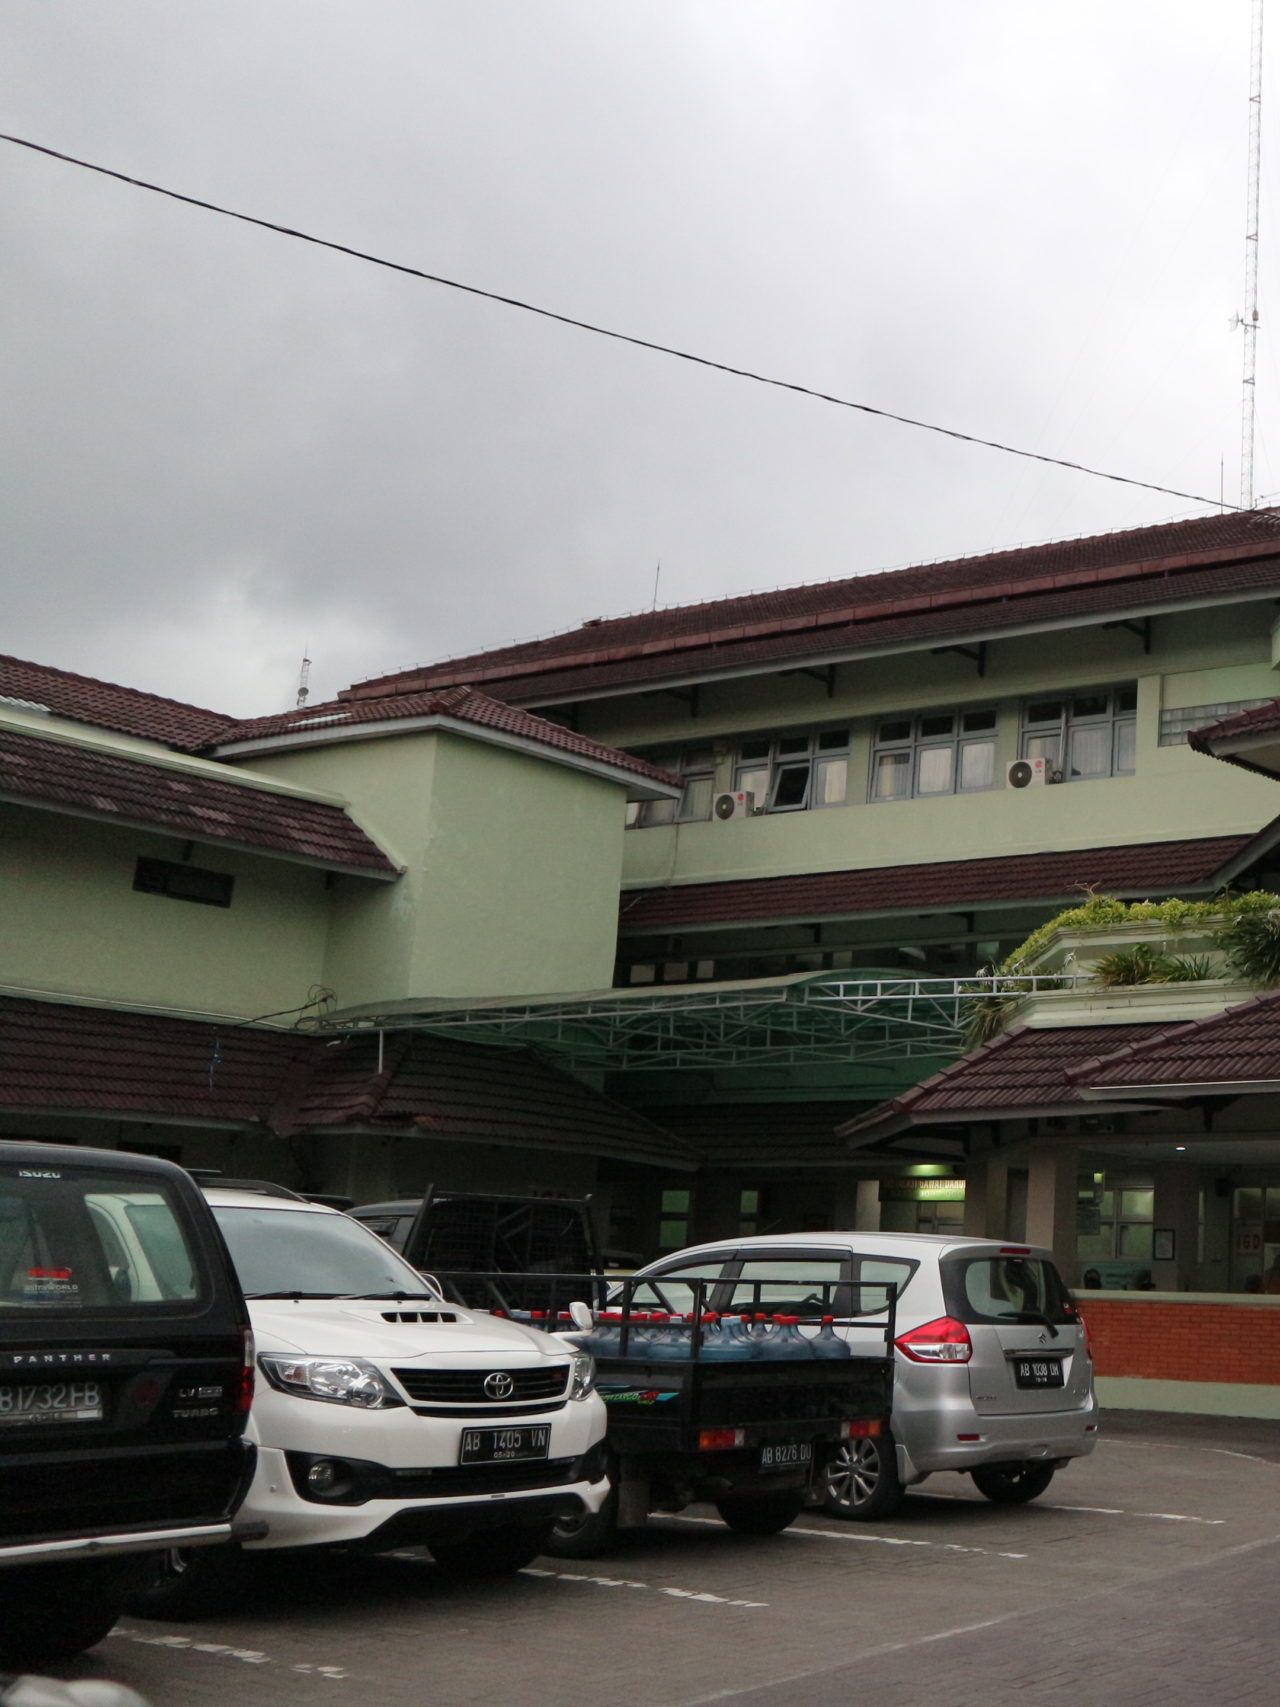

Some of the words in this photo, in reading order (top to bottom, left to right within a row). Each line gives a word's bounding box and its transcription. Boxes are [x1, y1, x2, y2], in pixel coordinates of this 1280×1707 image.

[13, 1354, 111, 1364] PANTHER
[465, 1432, 481, 1451] AB
[493, 1430, 521, 1449] 1405
[531, 1429, 546, 1447] VN
[761, 1447, 773, 1464] AB
